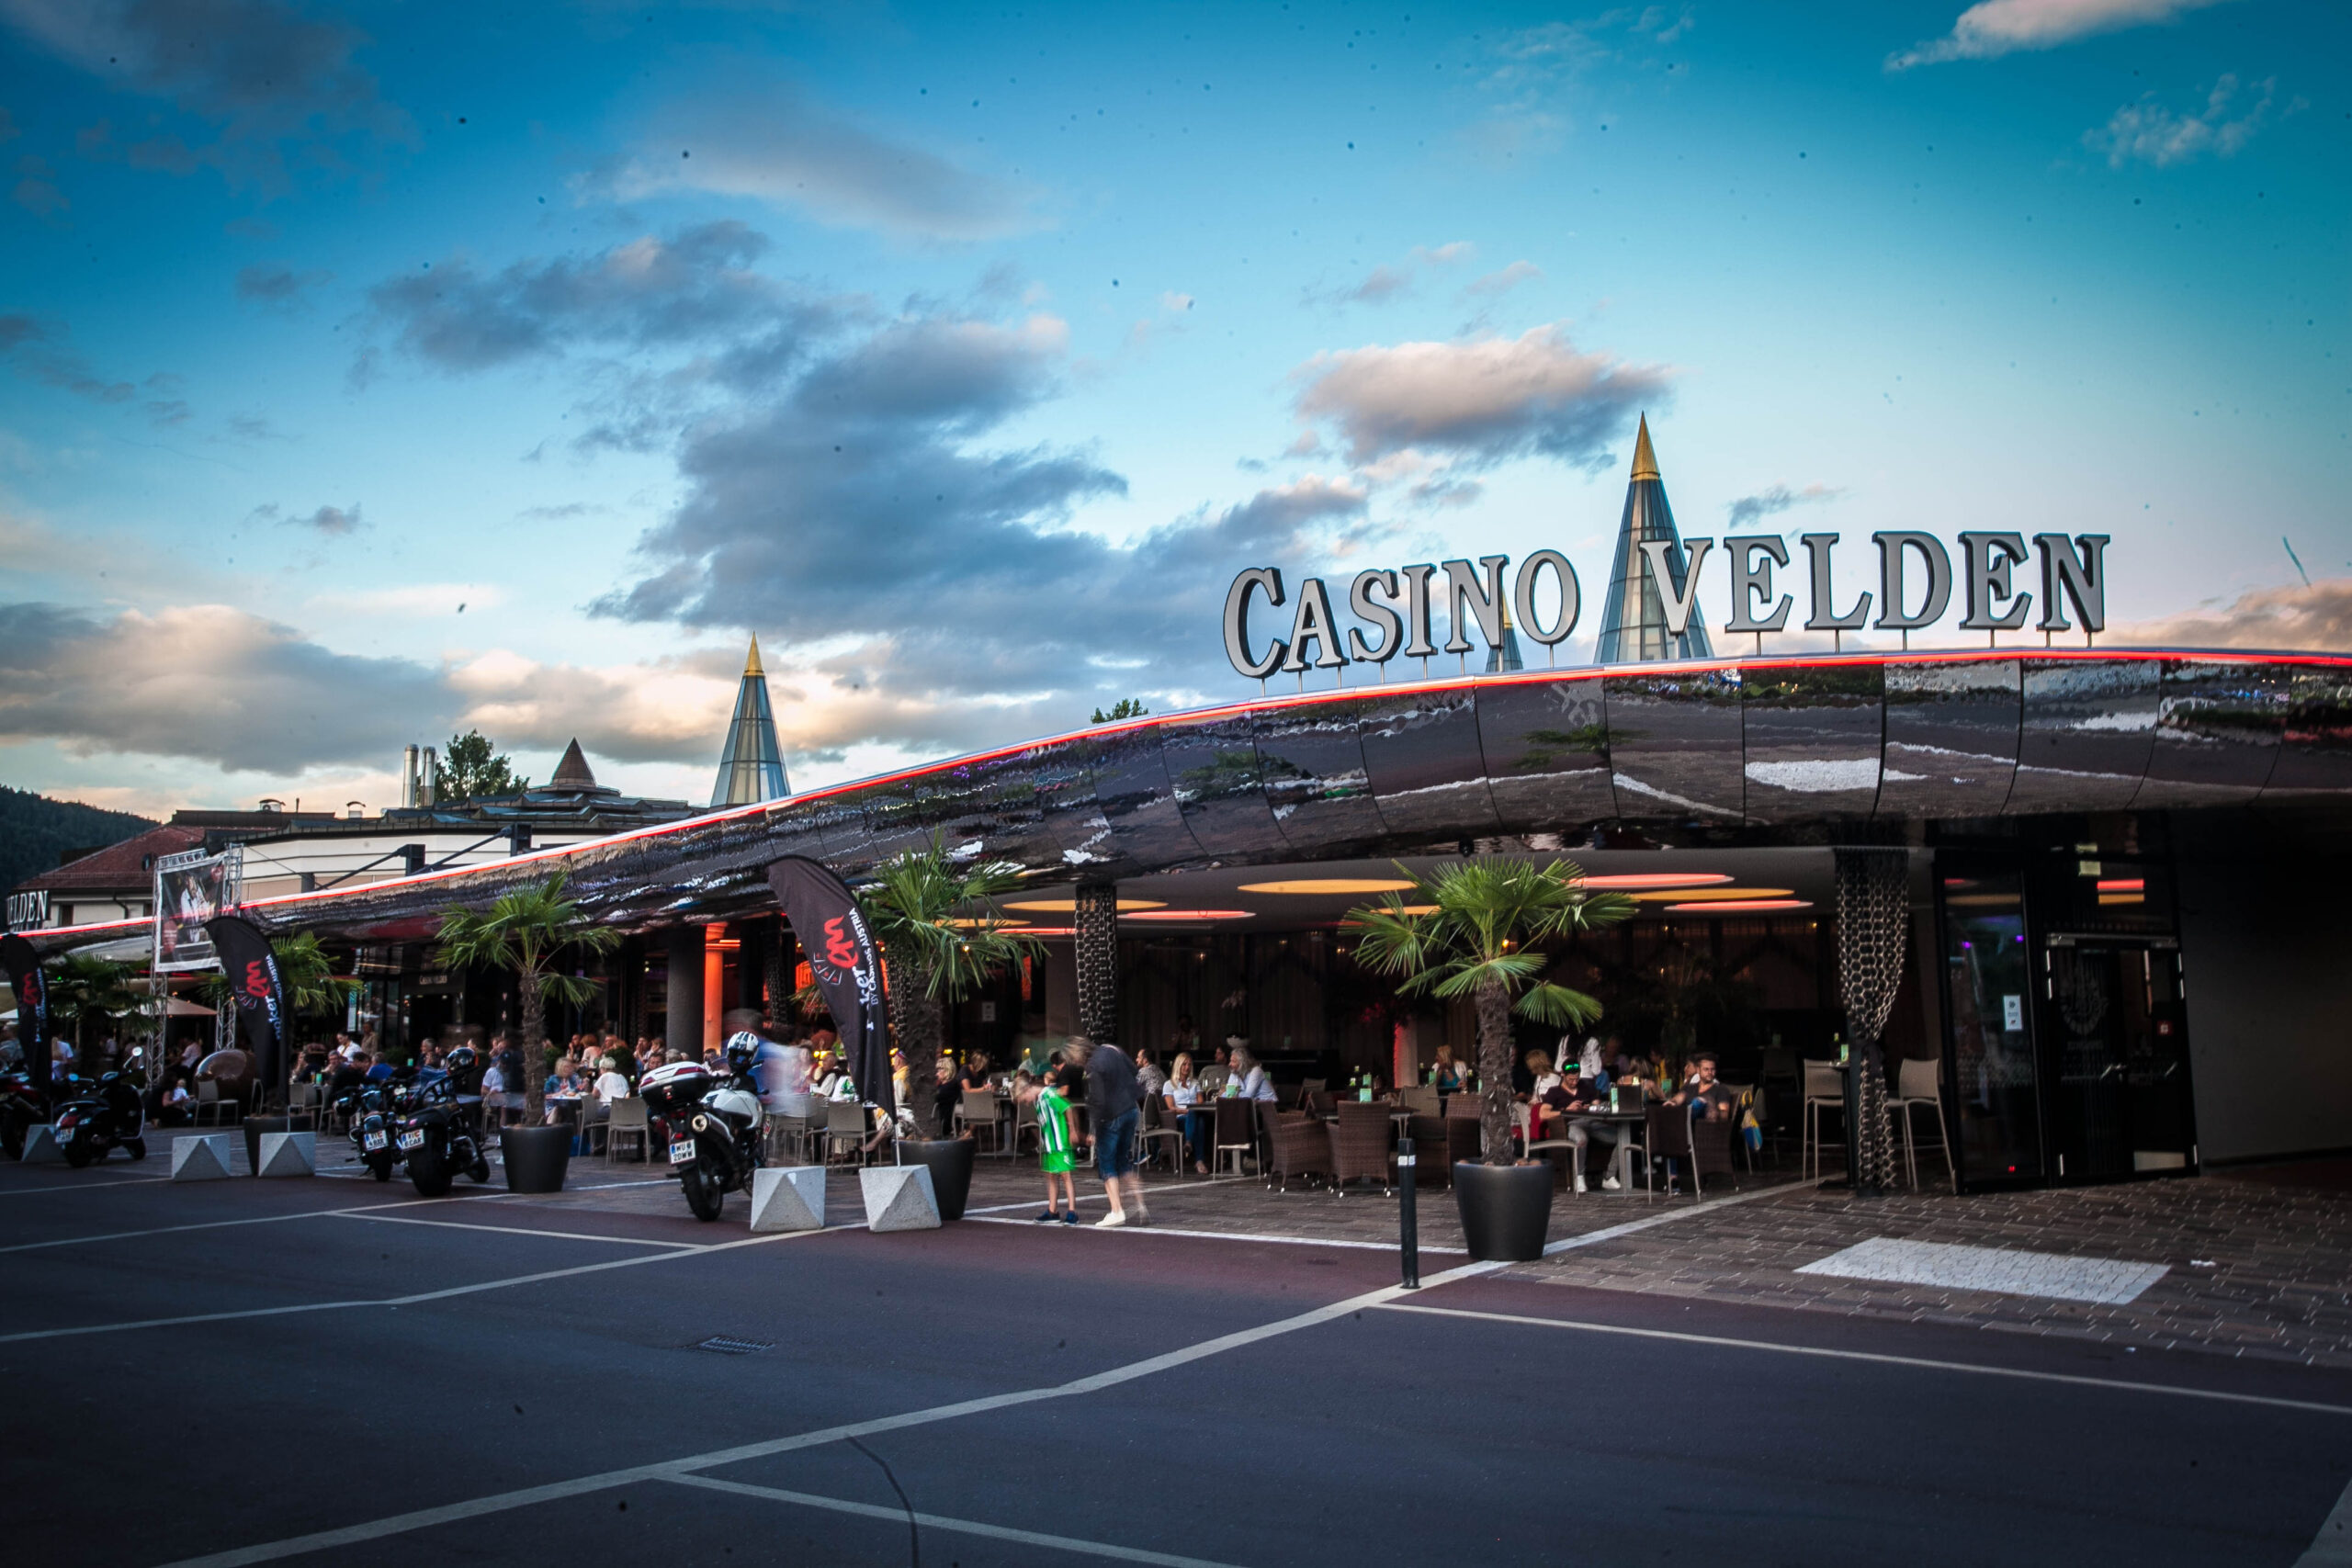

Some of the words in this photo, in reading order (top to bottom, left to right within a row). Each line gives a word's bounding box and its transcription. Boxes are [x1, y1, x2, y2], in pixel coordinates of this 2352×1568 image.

[1223, 548, 1581, 679] CASINO
[1639, 530, 2110, 635] VELDEN
[7, 890, 48, 925] ELDEN
[849, 907, 871, 947] AUSTRIA
[266, 953, 279, 983] AUSTRIA
[676, 1143, 686, 1152] WU
